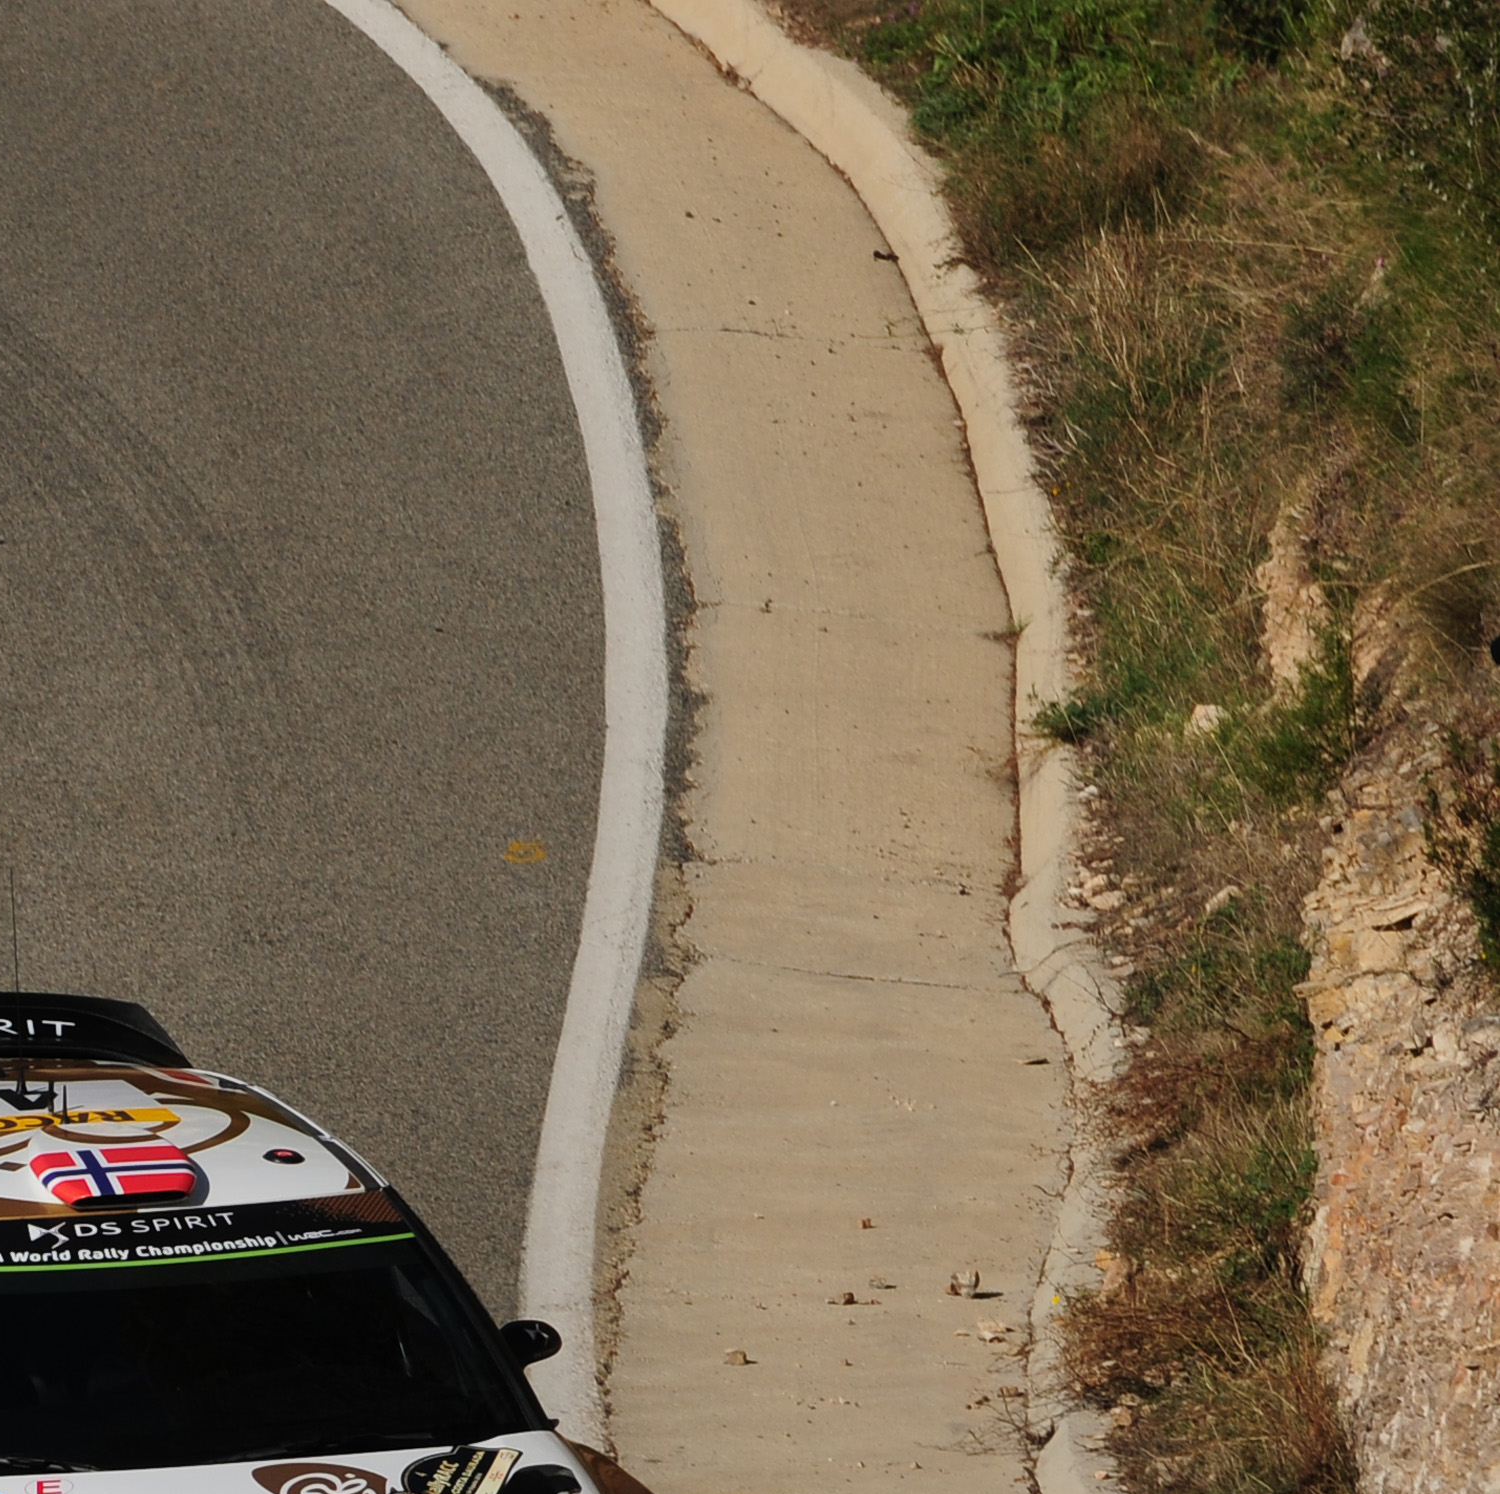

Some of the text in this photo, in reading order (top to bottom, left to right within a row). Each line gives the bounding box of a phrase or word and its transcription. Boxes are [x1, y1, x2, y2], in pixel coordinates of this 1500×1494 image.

[74, 1212, 235, 1238] DS SPIRIT
[10, 1250, 71, 1263] World
[78, 1247, 129, 1261] Rally
[136, 1235, 277, 1257] Championship
